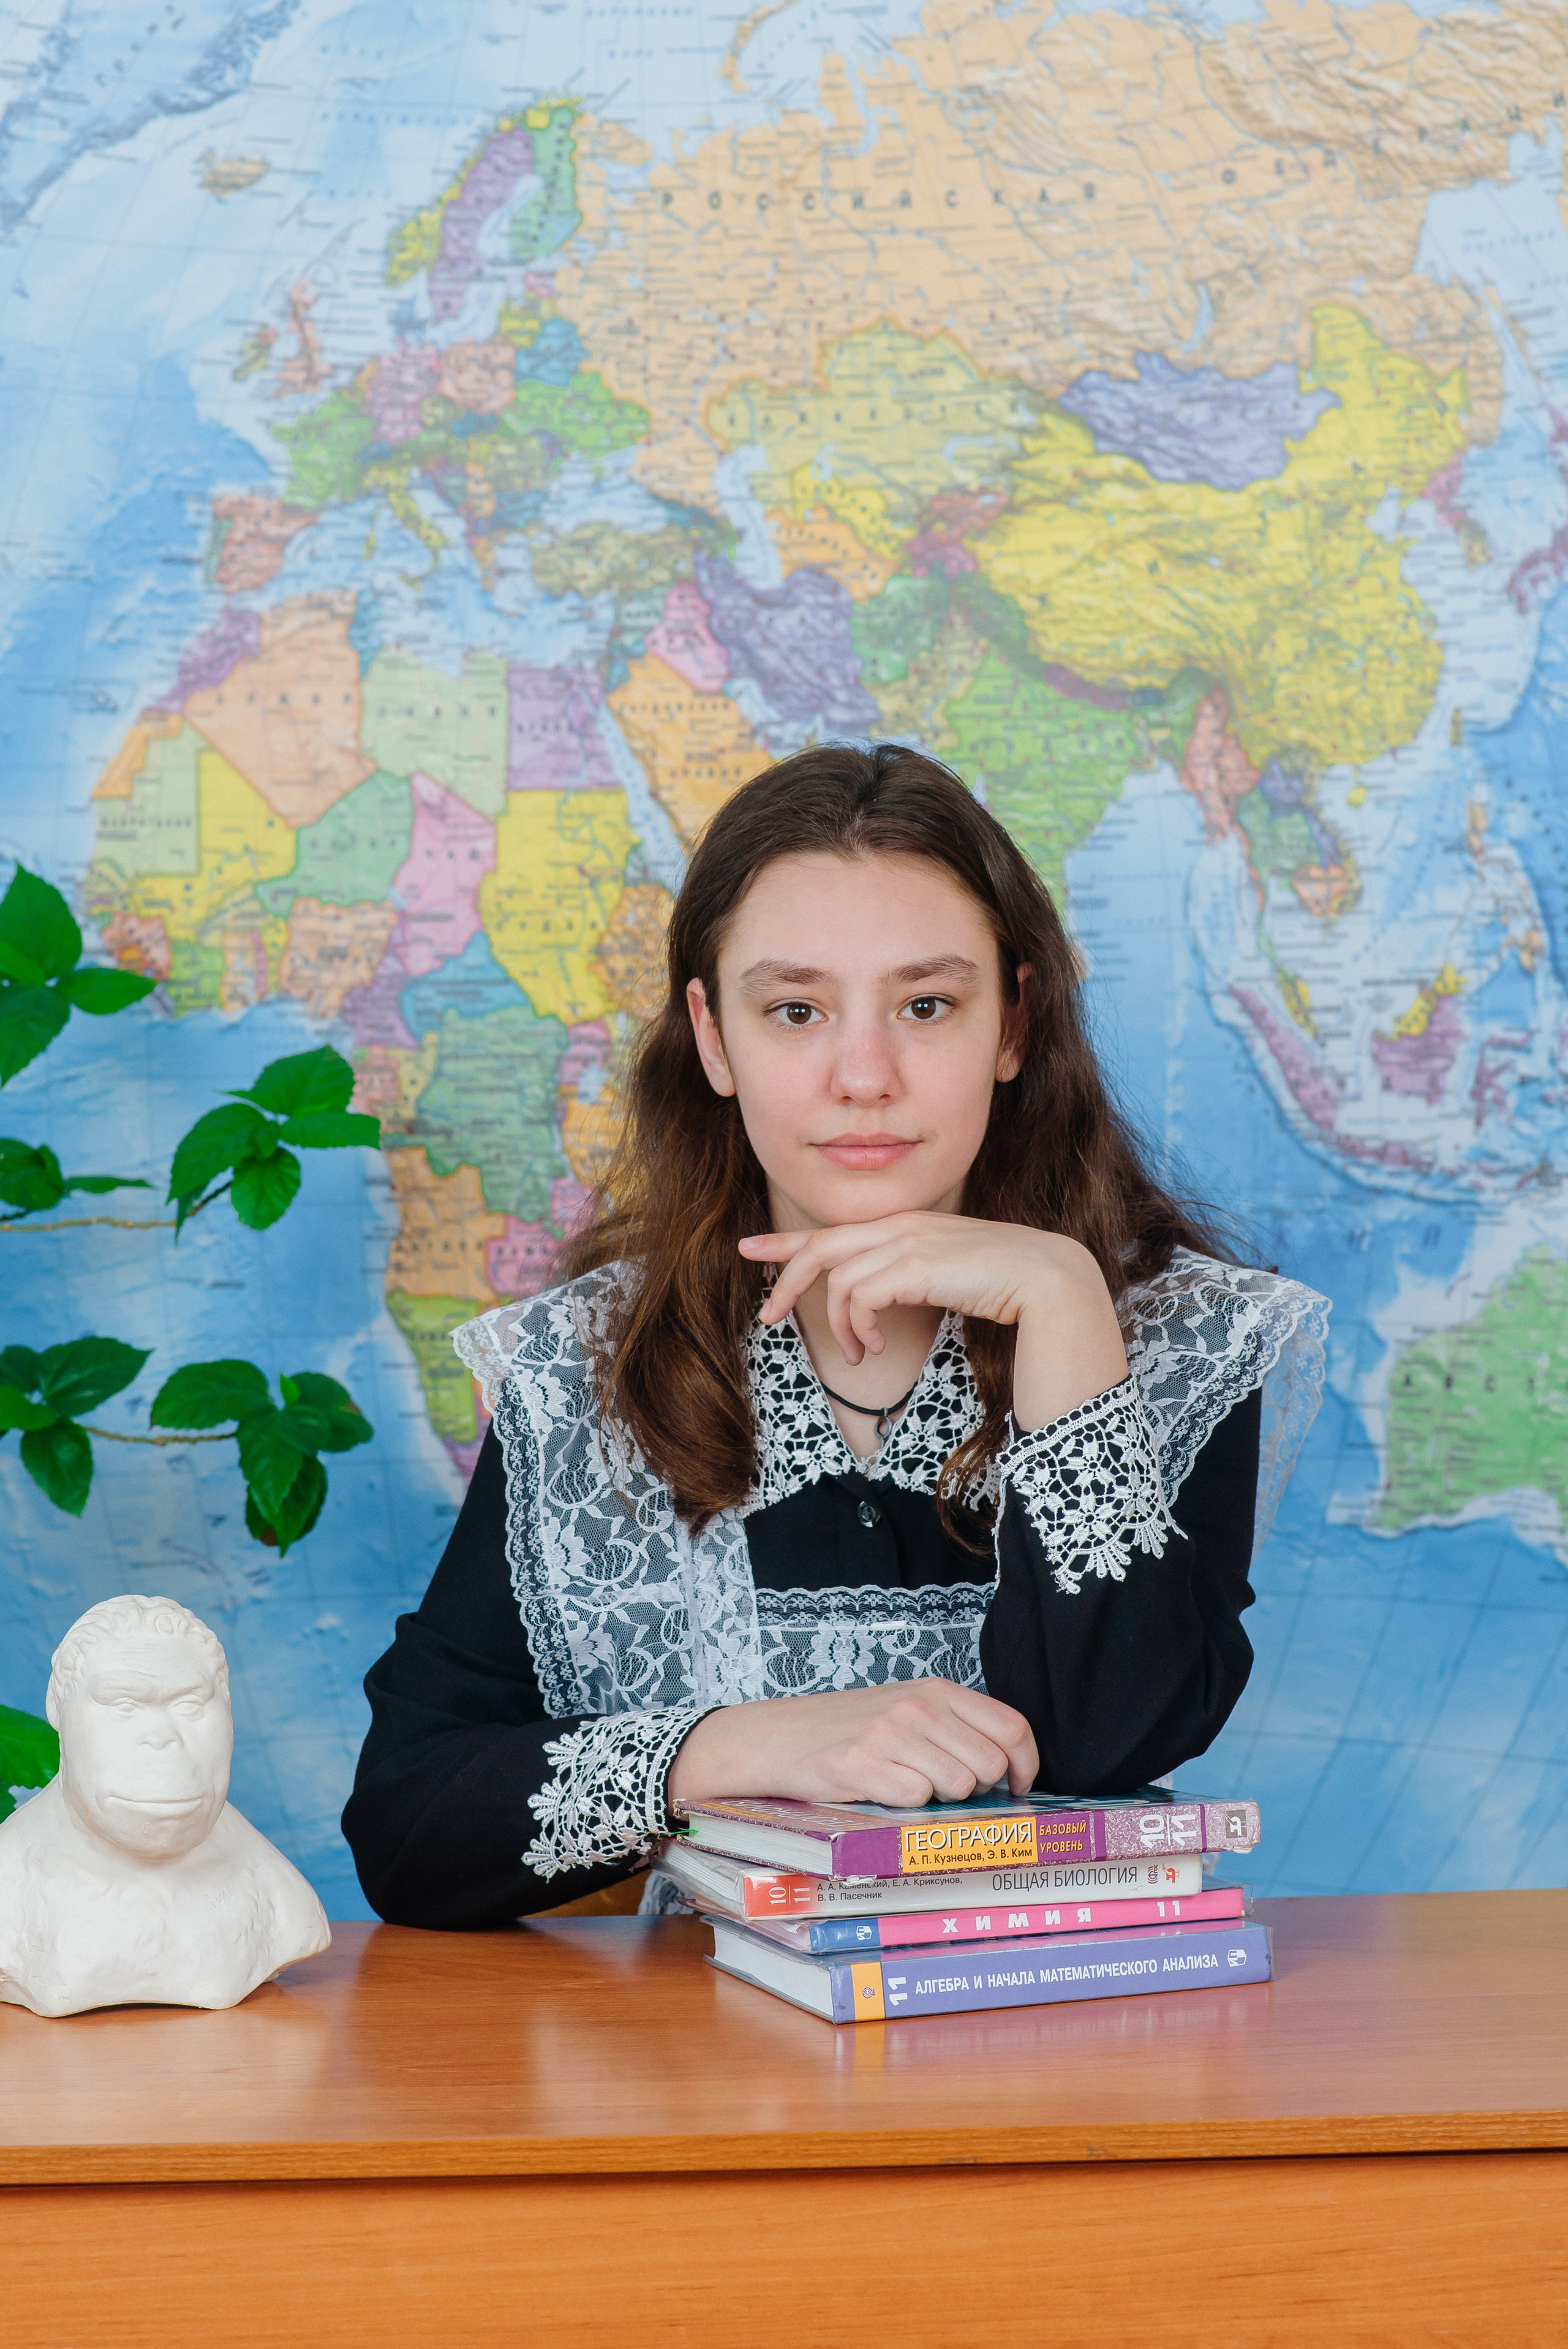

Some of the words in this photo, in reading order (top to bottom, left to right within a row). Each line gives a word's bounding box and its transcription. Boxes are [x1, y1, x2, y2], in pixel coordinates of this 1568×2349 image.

[905, 1822, 1032, 1852] ГЕОГРАФИЯ
[1039, 1820, 1087, 1836] БАЗОВЫЙ
[1139, 1814, 1164, 1849] 10
[1170, 1814, 1197, 1846] 11
[909, 1856, 919, 1865] А.
[922, 1855, 931, 1864] П.
[934, 1852, 985, 1865] Кузнецов,
[987, 1850, 998, 1859] Э.
[1001, 1849, 1009, 1858] В.
[1012, 1848, 1032, 1857] Ким
[1040, 1840, 1083, 1853] УРОВЕНЬ
[914, 1877, 963, 1887] Криксунов,
[992, 1871, 1049, 1892] ОБЩАЯ
[1054, 1866, 1137, 1887] БИОЛОГИЯ
[769, 1887, 786, 1905] 10
[794, 1887, 810, 1902] 11
[840, 1891, 883, 1900] Пасечник
[942, 1907, 1091, 1934] ХИМИЯ
[1157, 1900, 1180, 1917] 11
[915, 1977, 969, 1994] АЛГЕБРА
[974, 1975, 982, 1989] И
[987, 1970, 1035, 1988] НАЧАЛА
[1040, 1959, 1158, 1983] МАТЕМАТИЧЕСКОГО
[1163, 1954, 1219, 1972] АНАЛИЗА
[888, 1977, 908, 2006] 11
